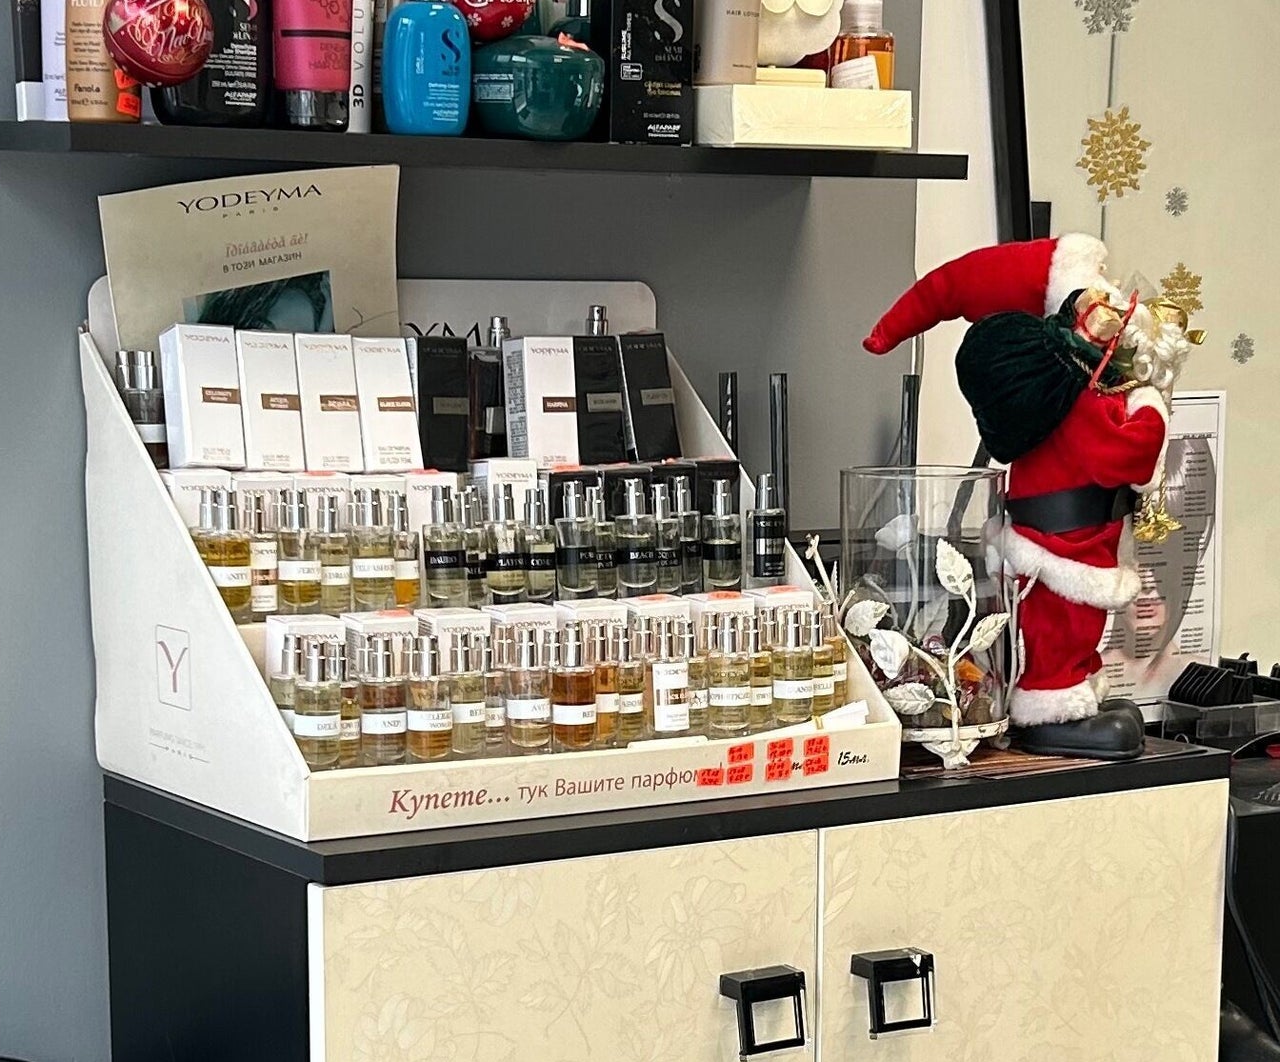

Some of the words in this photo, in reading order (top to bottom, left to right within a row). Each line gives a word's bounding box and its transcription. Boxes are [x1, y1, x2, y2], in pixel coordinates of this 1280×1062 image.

[352, 84, 364, 108] 3D
[178, 184, 322, 214] YODEYMA
[222, 206, 279, 218] PARIS
[222, 264, 229, 274] В
[231, 259, 255, 272] ТОЗИ
[258, 251, 302, 267] МАГАЗИН
[157, 640, 189, 693] Y
[388, 788, 510, 820] Купете...
[518, 784, 548, 804] тук
[554, 777, 625, 796] Вашите
